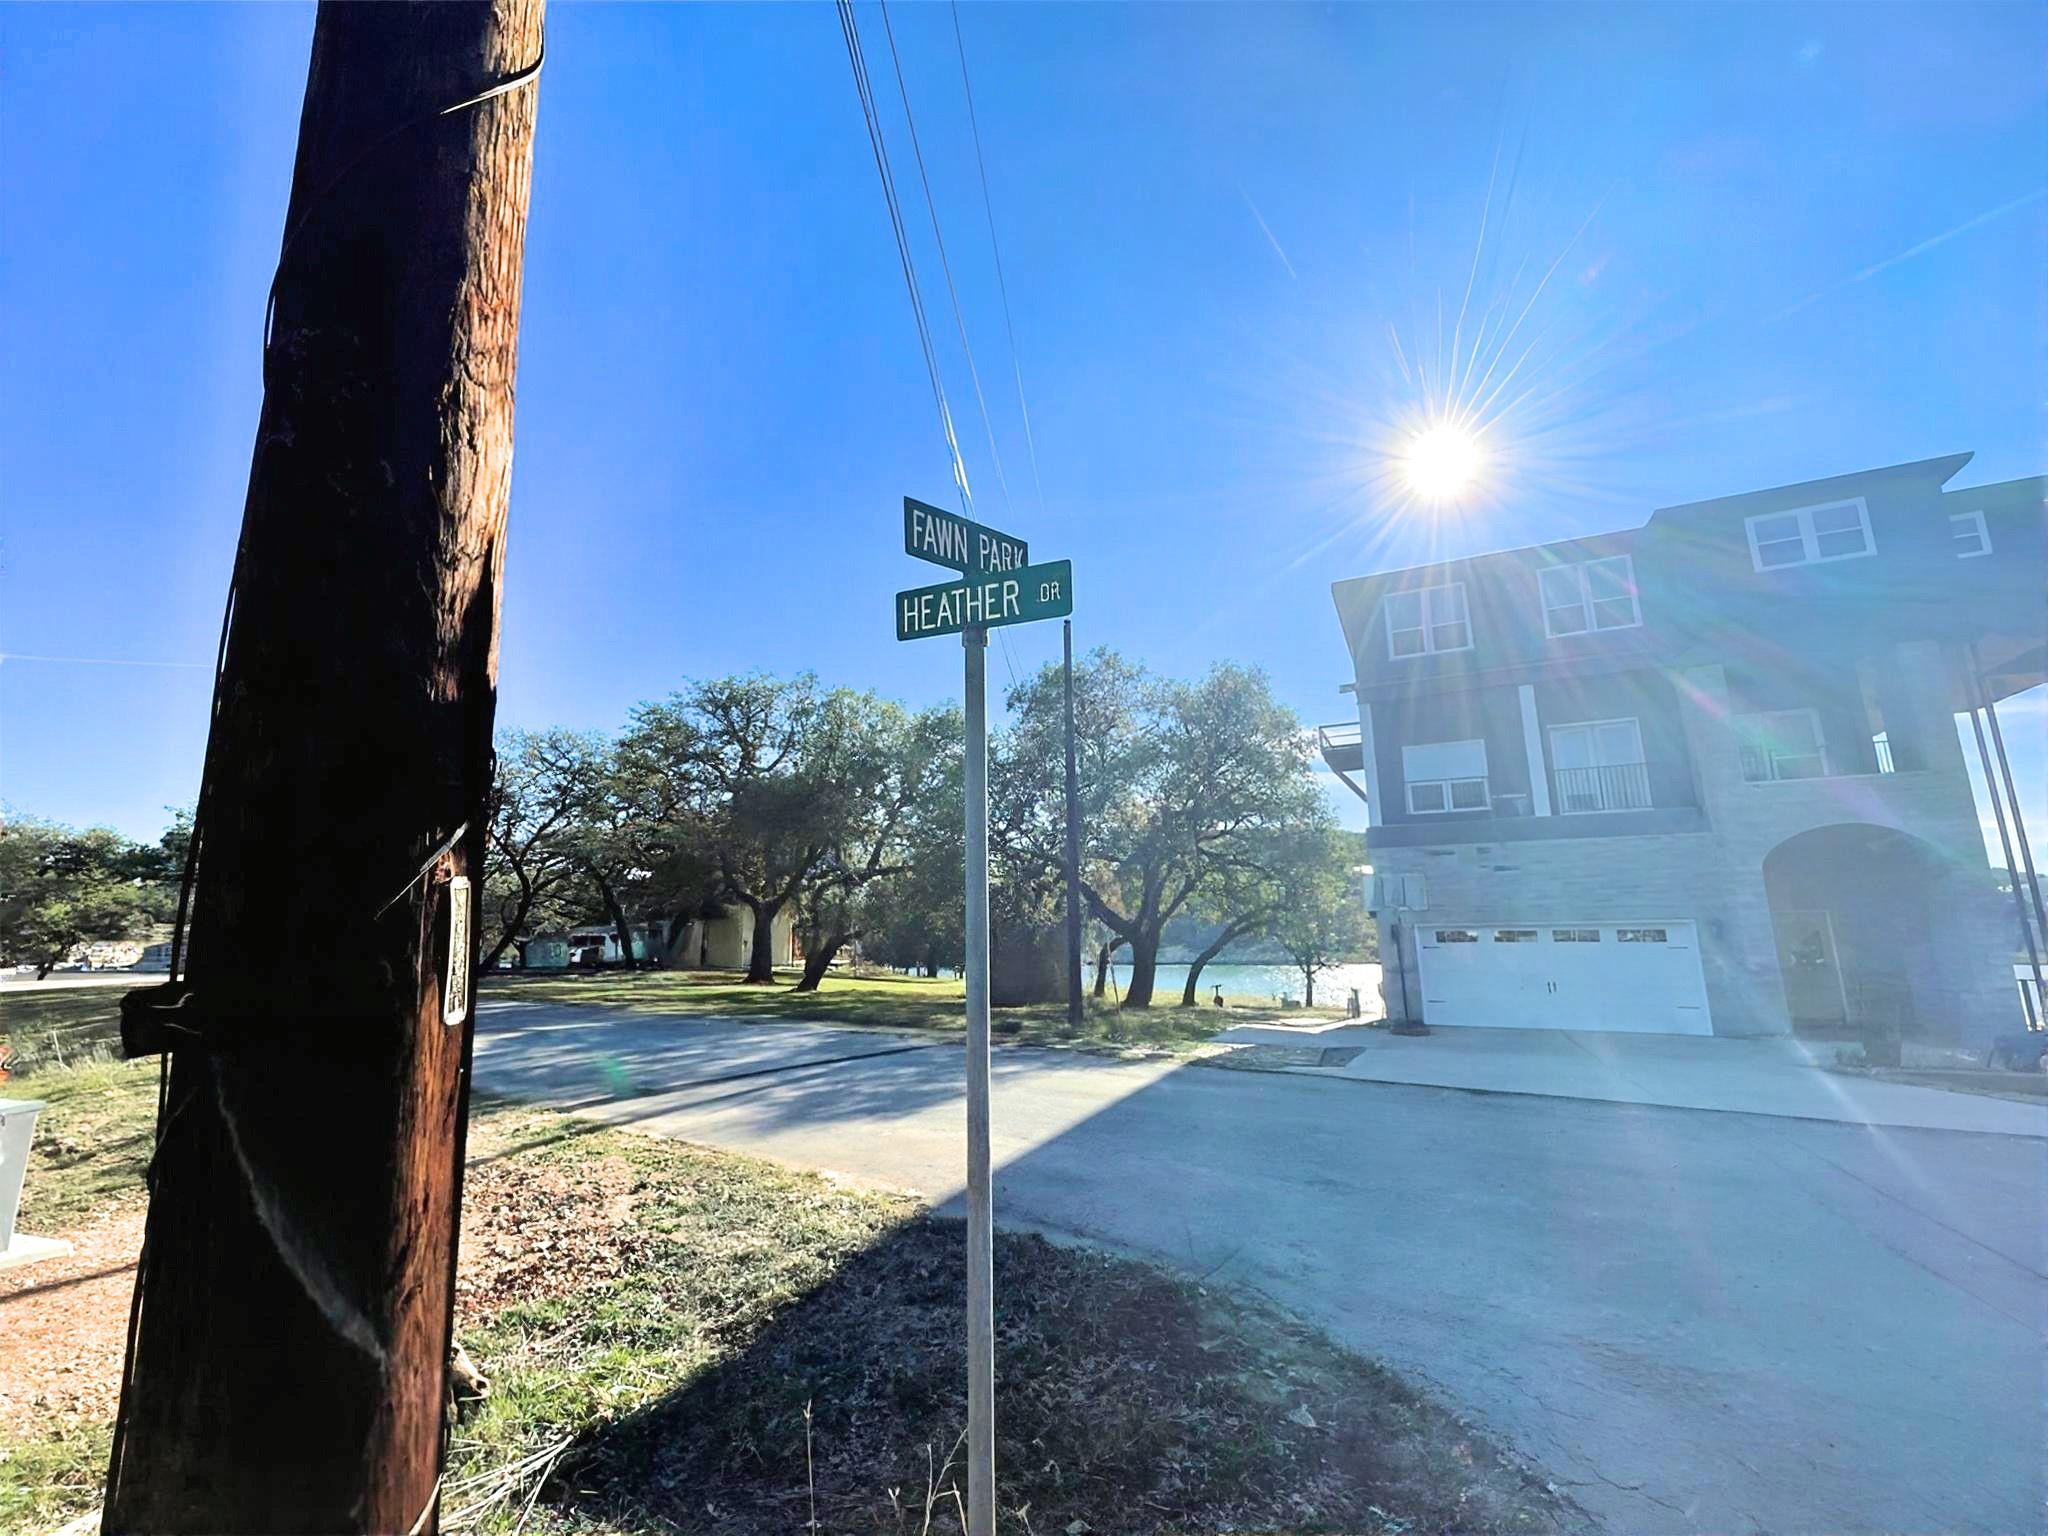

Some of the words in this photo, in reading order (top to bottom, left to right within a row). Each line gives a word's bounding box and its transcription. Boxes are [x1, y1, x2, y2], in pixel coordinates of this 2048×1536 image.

[913, 510, 968, 564] FAWN
[979, 533, 1024, 572] PARK
[904, 580, 1020, 632] HEATHER
[1040, 582, 1061, 602] DR
